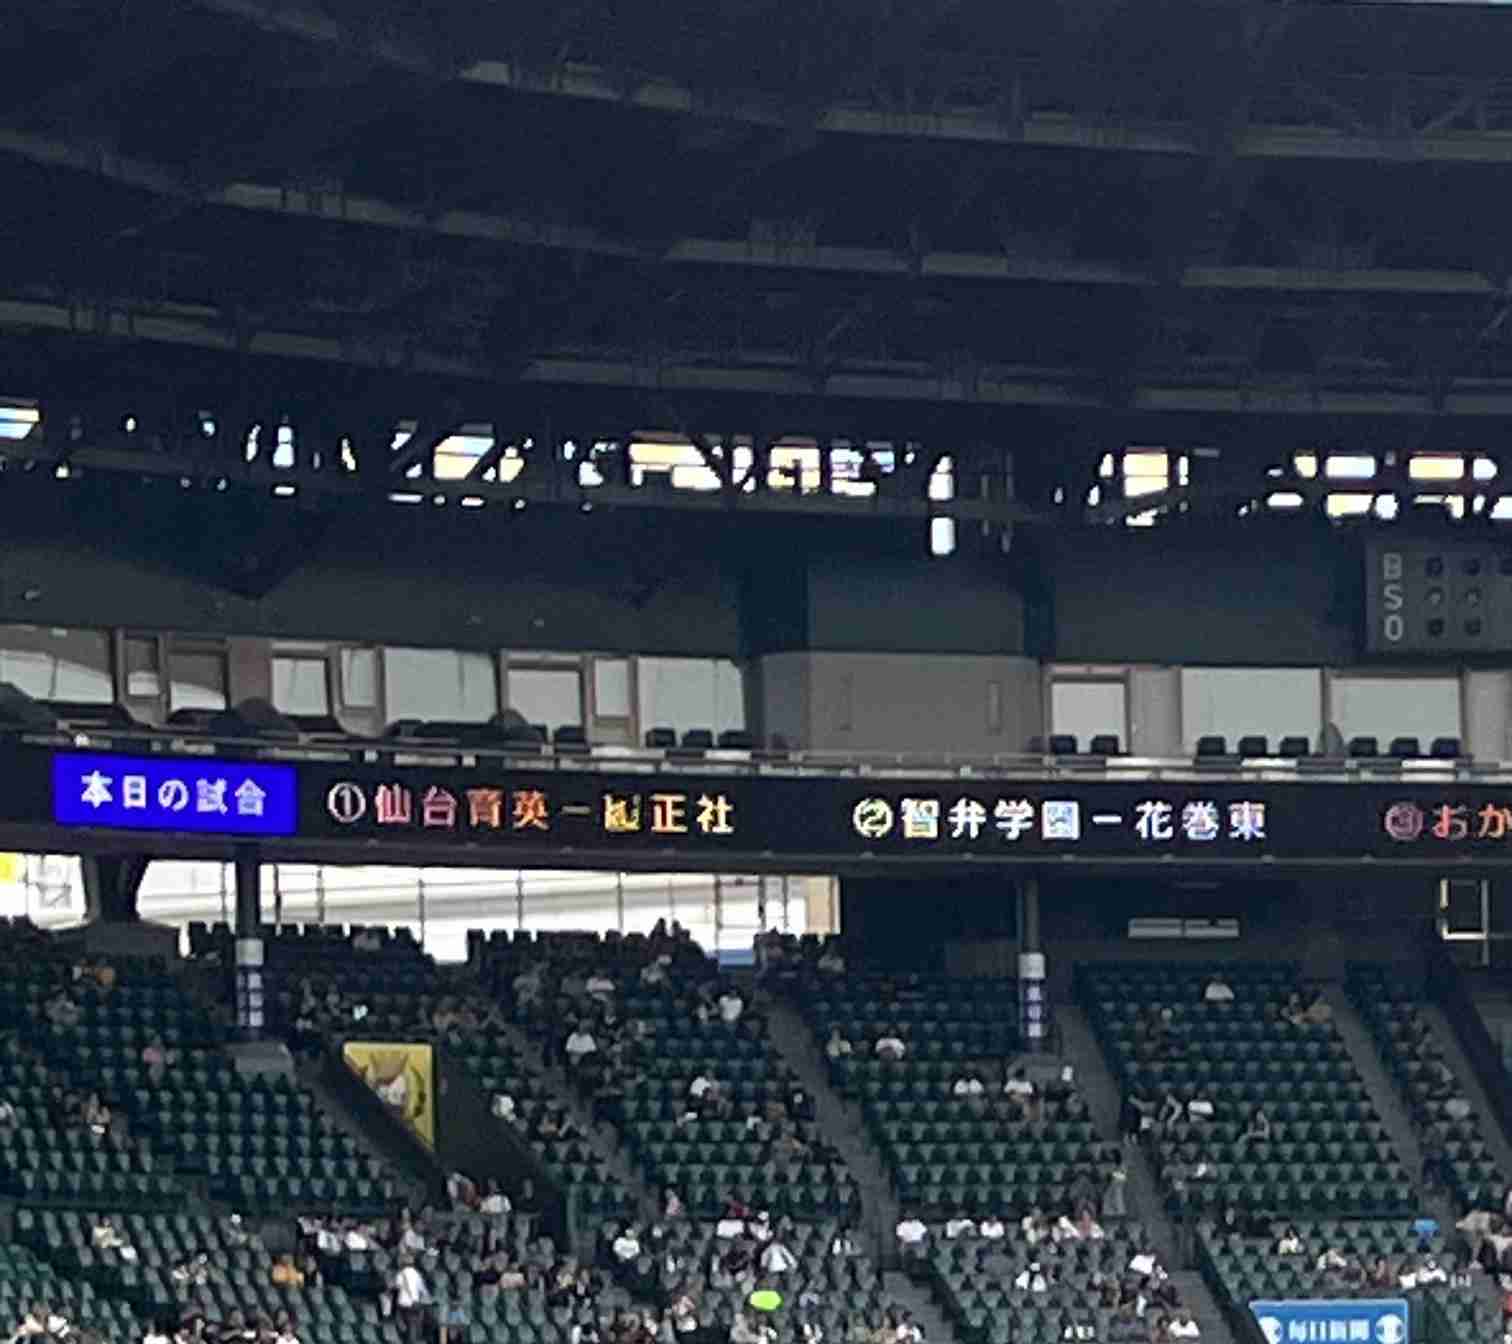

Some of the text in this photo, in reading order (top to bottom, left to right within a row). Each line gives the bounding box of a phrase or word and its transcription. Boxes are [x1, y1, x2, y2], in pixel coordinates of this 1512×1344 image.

[1384, 584, 1403, 610] S
[81, 770, 267, 816] 本日の試合
